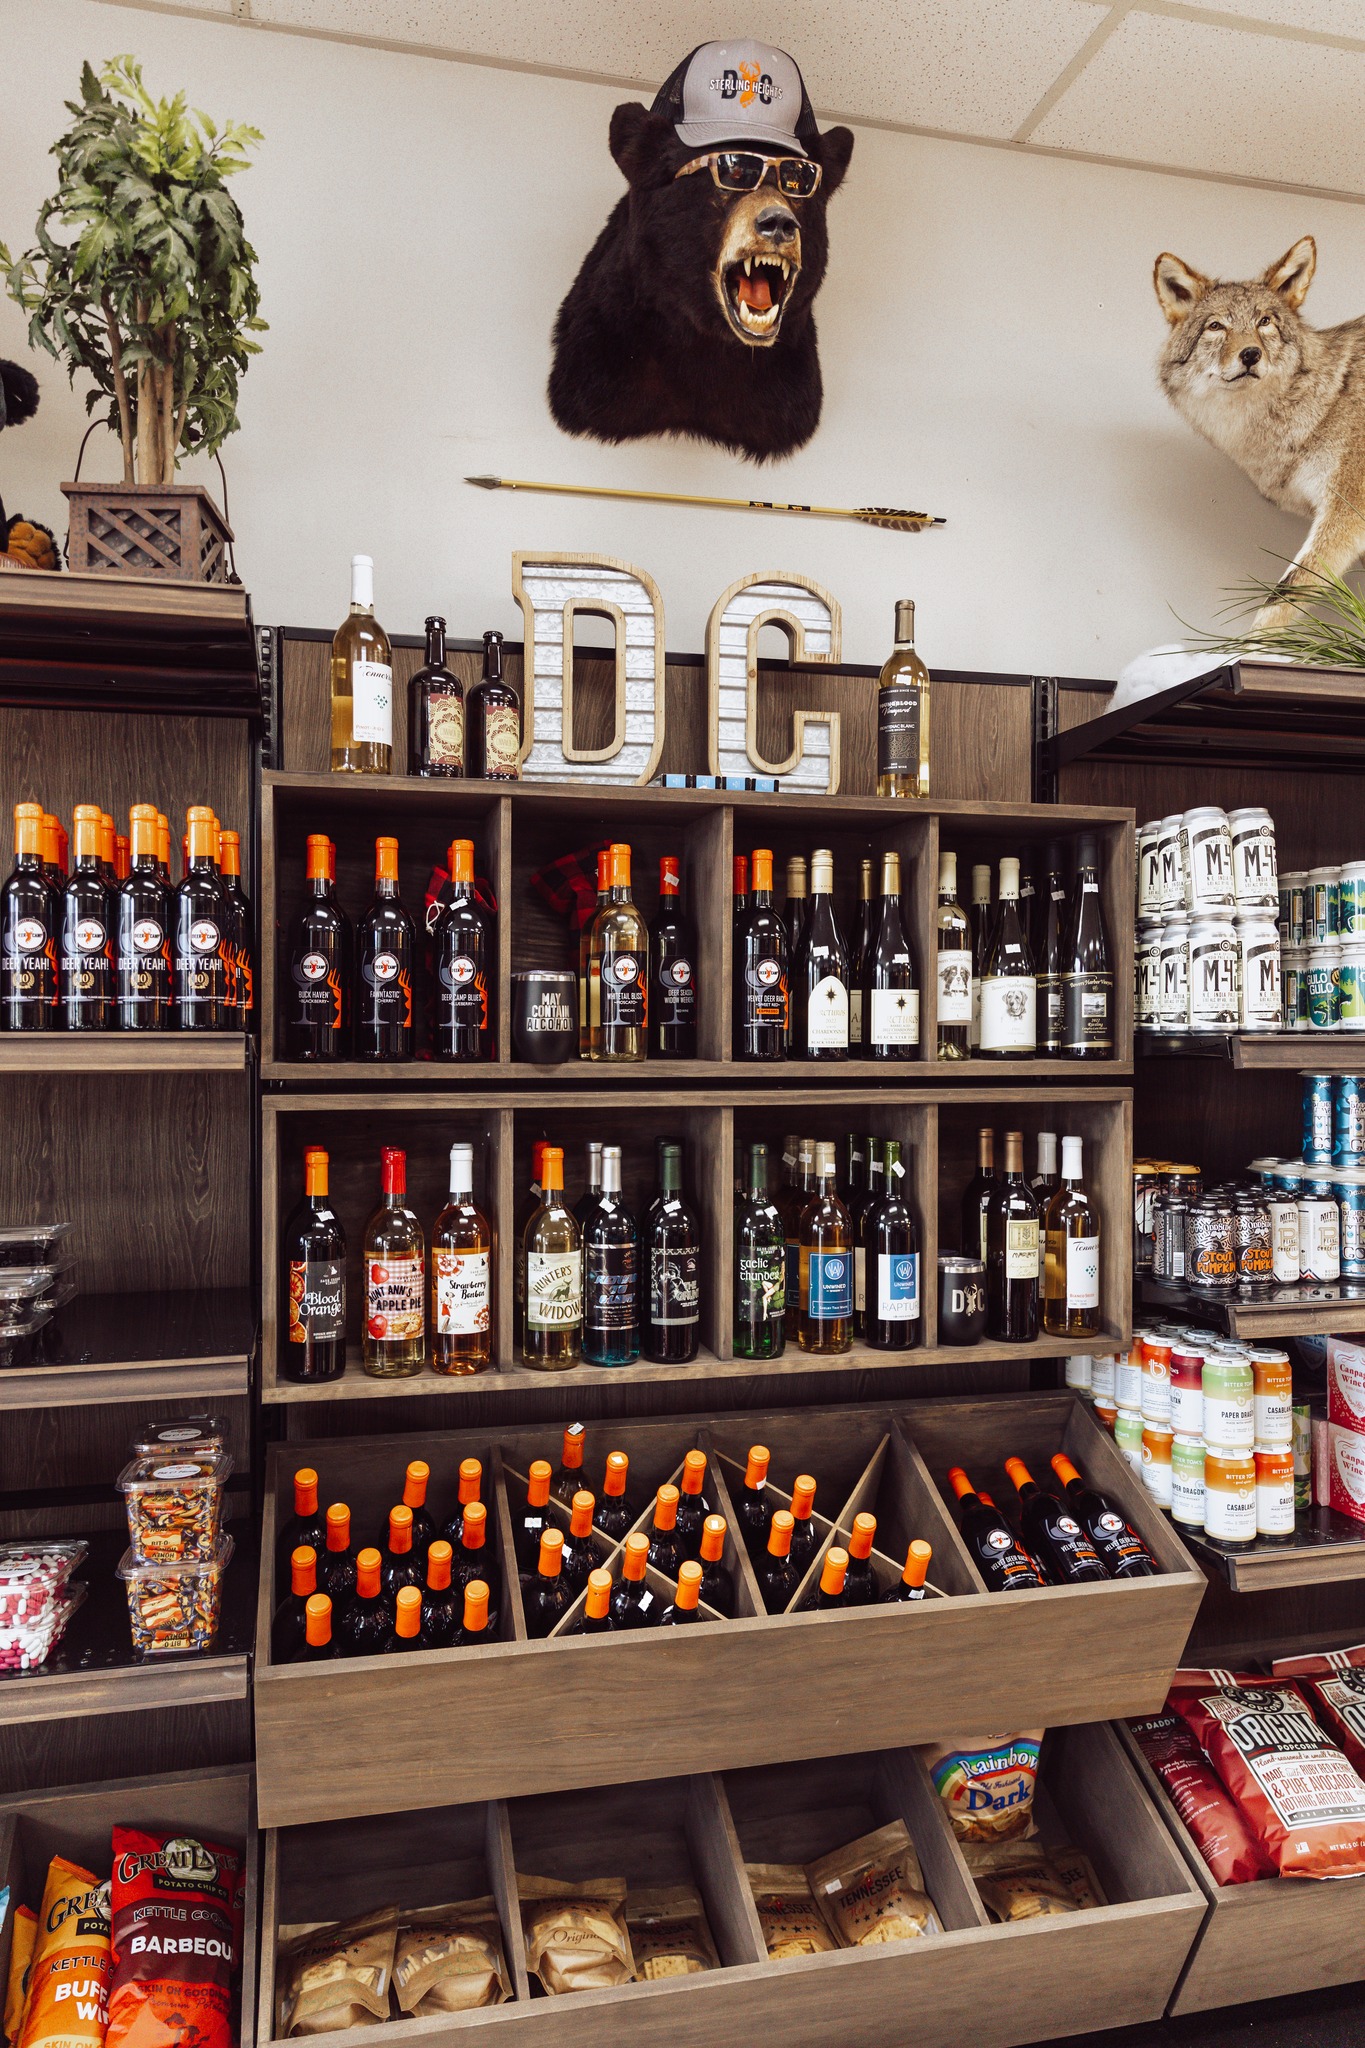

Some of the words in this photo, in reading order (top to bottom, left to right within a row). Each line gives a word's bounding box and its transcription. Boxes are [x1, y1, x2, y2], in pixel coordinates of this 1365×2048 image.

[710, 79, 750, 92] STERLING
[752, 82, 783, 101] HEIGHTS
[880, 700, 917, 708] YOUNGBLOOD
[23, 957, 49, 971] YEAH!
[83, 957, 109, 971] YEAH!
[140, 957, 165, 971] YEAH!
[176, 957, 197, 971] DEER
[198, 957, 222, 971] YEAH!
[1306, 972, 1328, 985] GULO
[298, 990, 311, 999] BUCK
[1309, 981, 1334, 995] GULO
[441, 993, 453, 1001] DEER
[453, 993, 466, 1001] CAMP
[542, 993, 562, 1005] MAY
[747, 994, 763, 1002] VELVET
[764, 994, 776, 1002] DEER
[532, 1004, 570, 1018] CONTAIN
[527, 1018, 574, 1032] ALCOHOL
[1202, 1251, 1233, 1263] STOUT
[1246, 1247, 1273, 1260] STOUT
[449, 1280, 487, 1290] Strawberry
[310, 1290, 340, 1306] Blood
[369, 1287, 385, 1304] AUNT
[388, 1285, 413, 1298] ANN'S
[461, 1288, 485, 1301] Bonbon
[300, 1303, 342, 1317] Orange
[376, 1299, 407, 1311] APPLE
[410, 1296, 422, 1309] PIE
[539, 1300, 582, 1321] WIDOW
[1342, 1373, 1361, 1388] Wine
[1221, 1411, 1240, 1419] PAPER
[1342, 1461, 1363, 1475] Wine
[1213, 1701, 1233, 1714] BOLD
[1240, 1699, 1282, 1713] POPCORN
[1146, 1717, 1177, 1730] DADDY
[1277, 1743, 1319, 1751] POPCORN
[1255, 1752, 1303, 1768] Hand-seasoned
[1311, 1751, 1327, 1760] small
[1262, 1767, 1285, 1784] MADE
[1300, 1764, 1318, 1776] RUBY
[1318, 1763, 1333, 1774] RED
[1271, 1783, 1285, 1799] &
[1281, 1777, 1312, 1796] PURE
[1308, 1774, 1355, 1792] AVOCADO
[966, 1780, 1032, 1812] Dark
[1279, 1794, 1318, 1814] NOTHING
[1315, 1790, 1357, 1807] ARTIFICIAL
[1292, 1811, 1317, 1819] MADE
[1329, 1843, 1339, 1851] NET
[119, 1847, 191, 1884] GREAT
[158, 1878, 194, 1888] POTATO
[197, 1883, 216, 1892] CHIP
[838, 1865, 904, 1909] TENNESSEE
[134, 1906, 186, 1922] KETTLE
[847, 1903, 867, 1919] Hot
[49, 1955, 105, 1975] KETTLE
[137, 1983, 163, 1994] SKIN
[166, 1984, 181, 1995] ON
